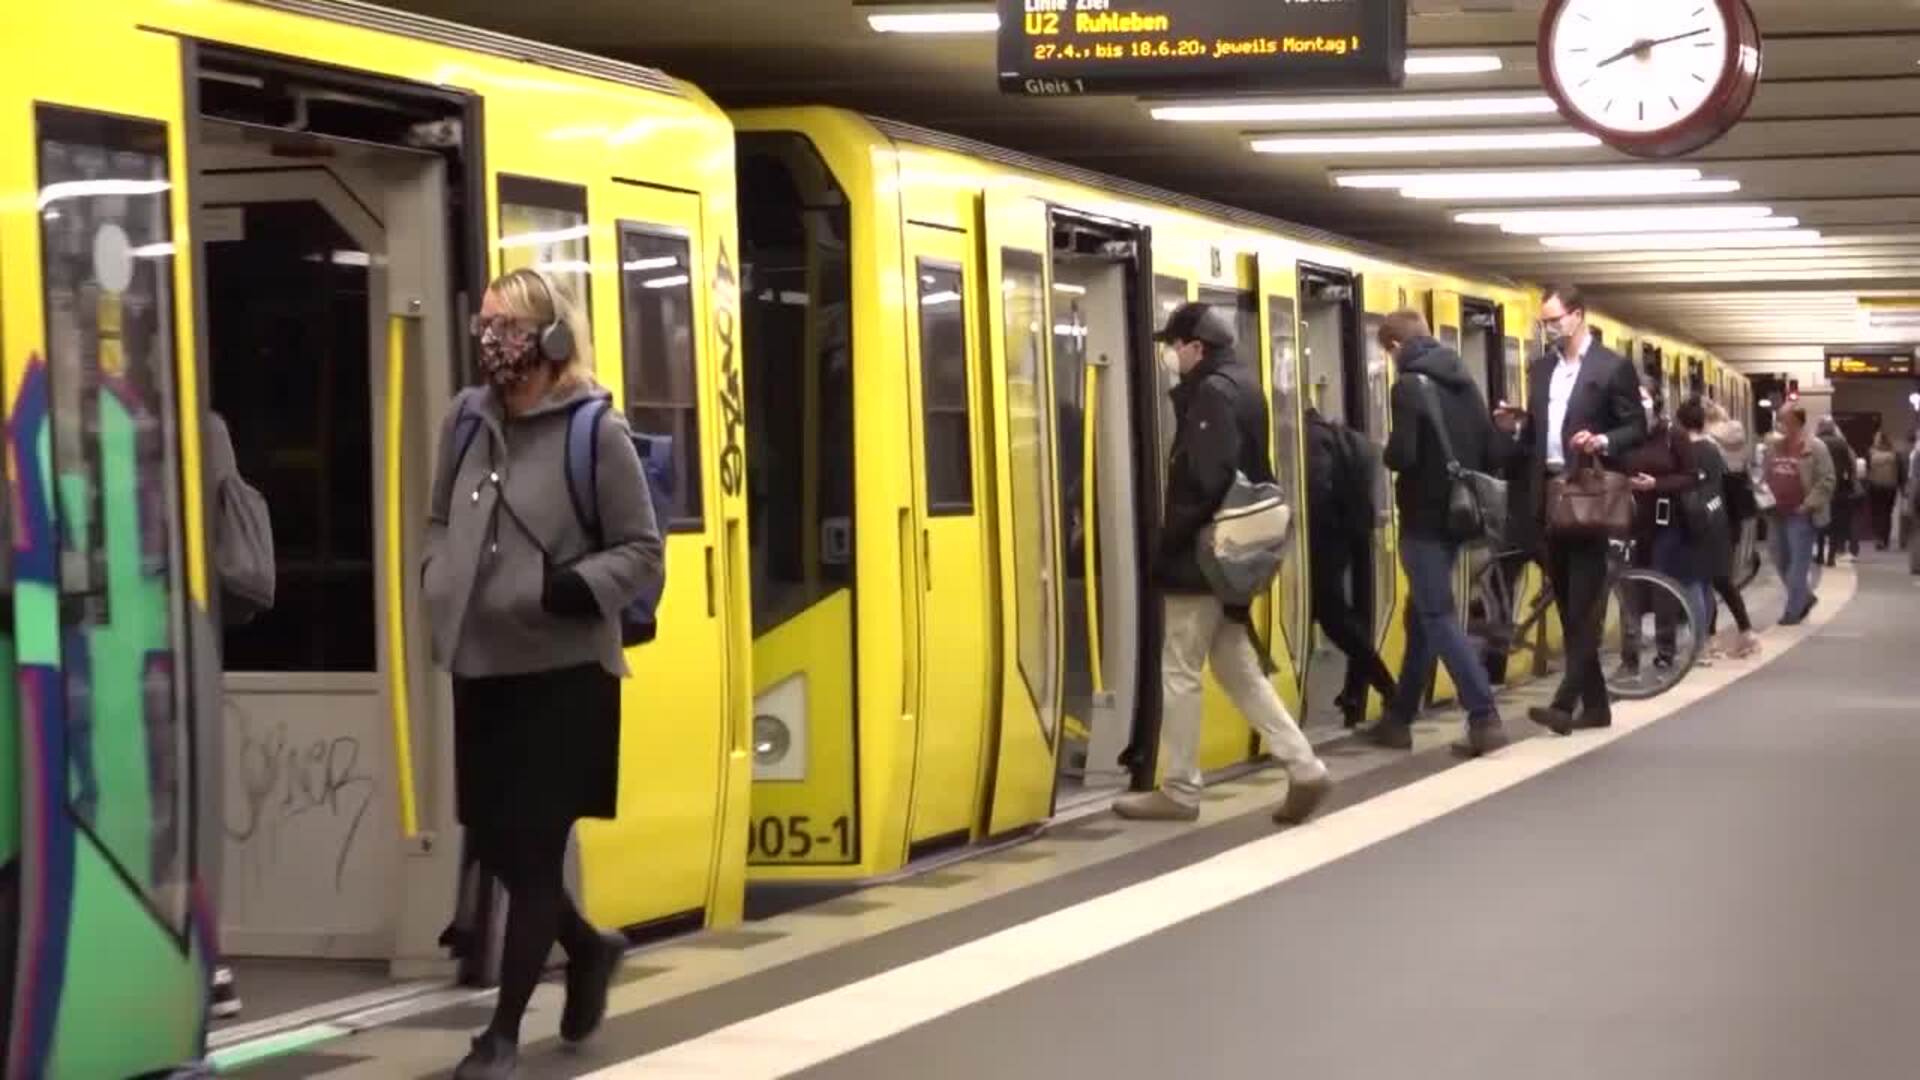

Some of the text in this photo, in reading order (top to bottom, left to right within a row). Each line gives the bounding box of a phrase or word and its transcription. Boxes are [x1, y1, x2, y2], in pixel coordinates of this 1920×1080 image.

[1025, 11, 1169, 35] U2 Ruhleben
[1095, 43, 1124, 58] bis
[1212, 38, 1277, 58] jeweils
[1283, 36, 1346, 55] Montag
[1025, 78, 1084, 94] Gleis 1
